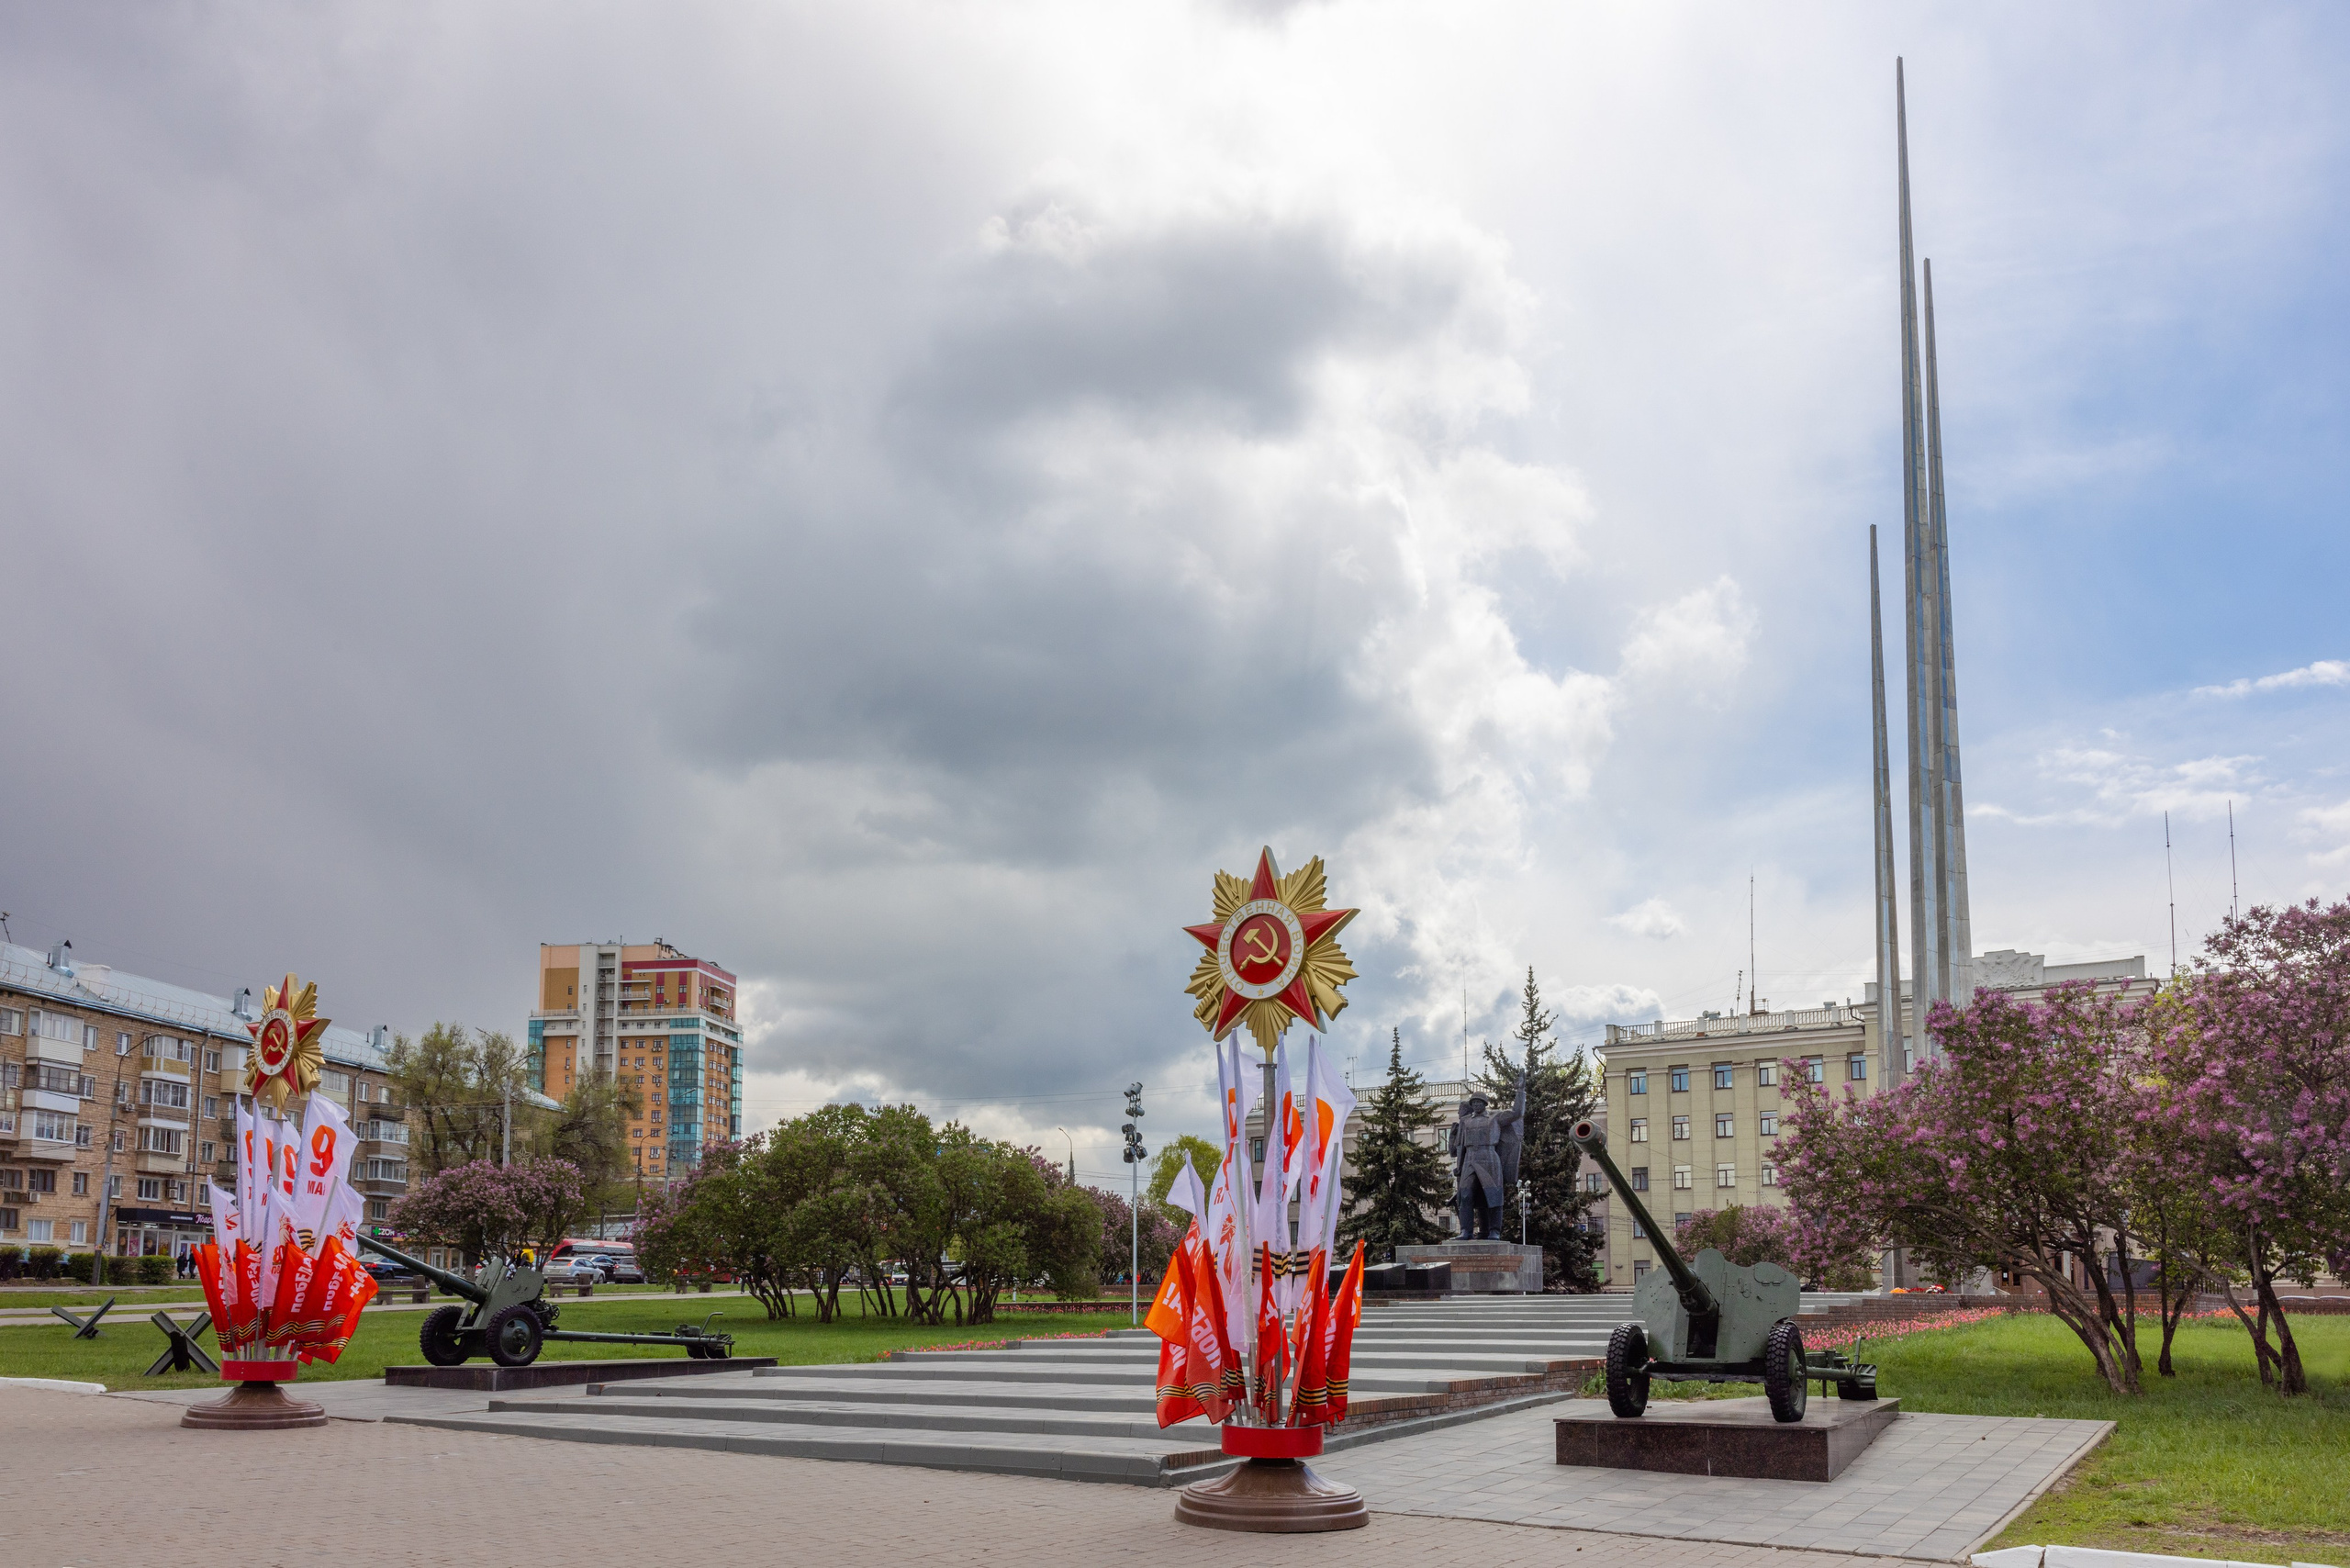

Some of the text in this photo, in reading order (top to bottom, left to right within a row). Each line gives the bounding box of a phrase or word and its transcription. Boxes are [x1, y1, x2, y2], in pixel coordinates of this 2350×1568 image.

[1219, 902, 1295, 991] ОТЕЧЕСТВЕННАЯ
[310, 1124, 337, 1178] 9
[307, 1180, 327, 1196] МА
